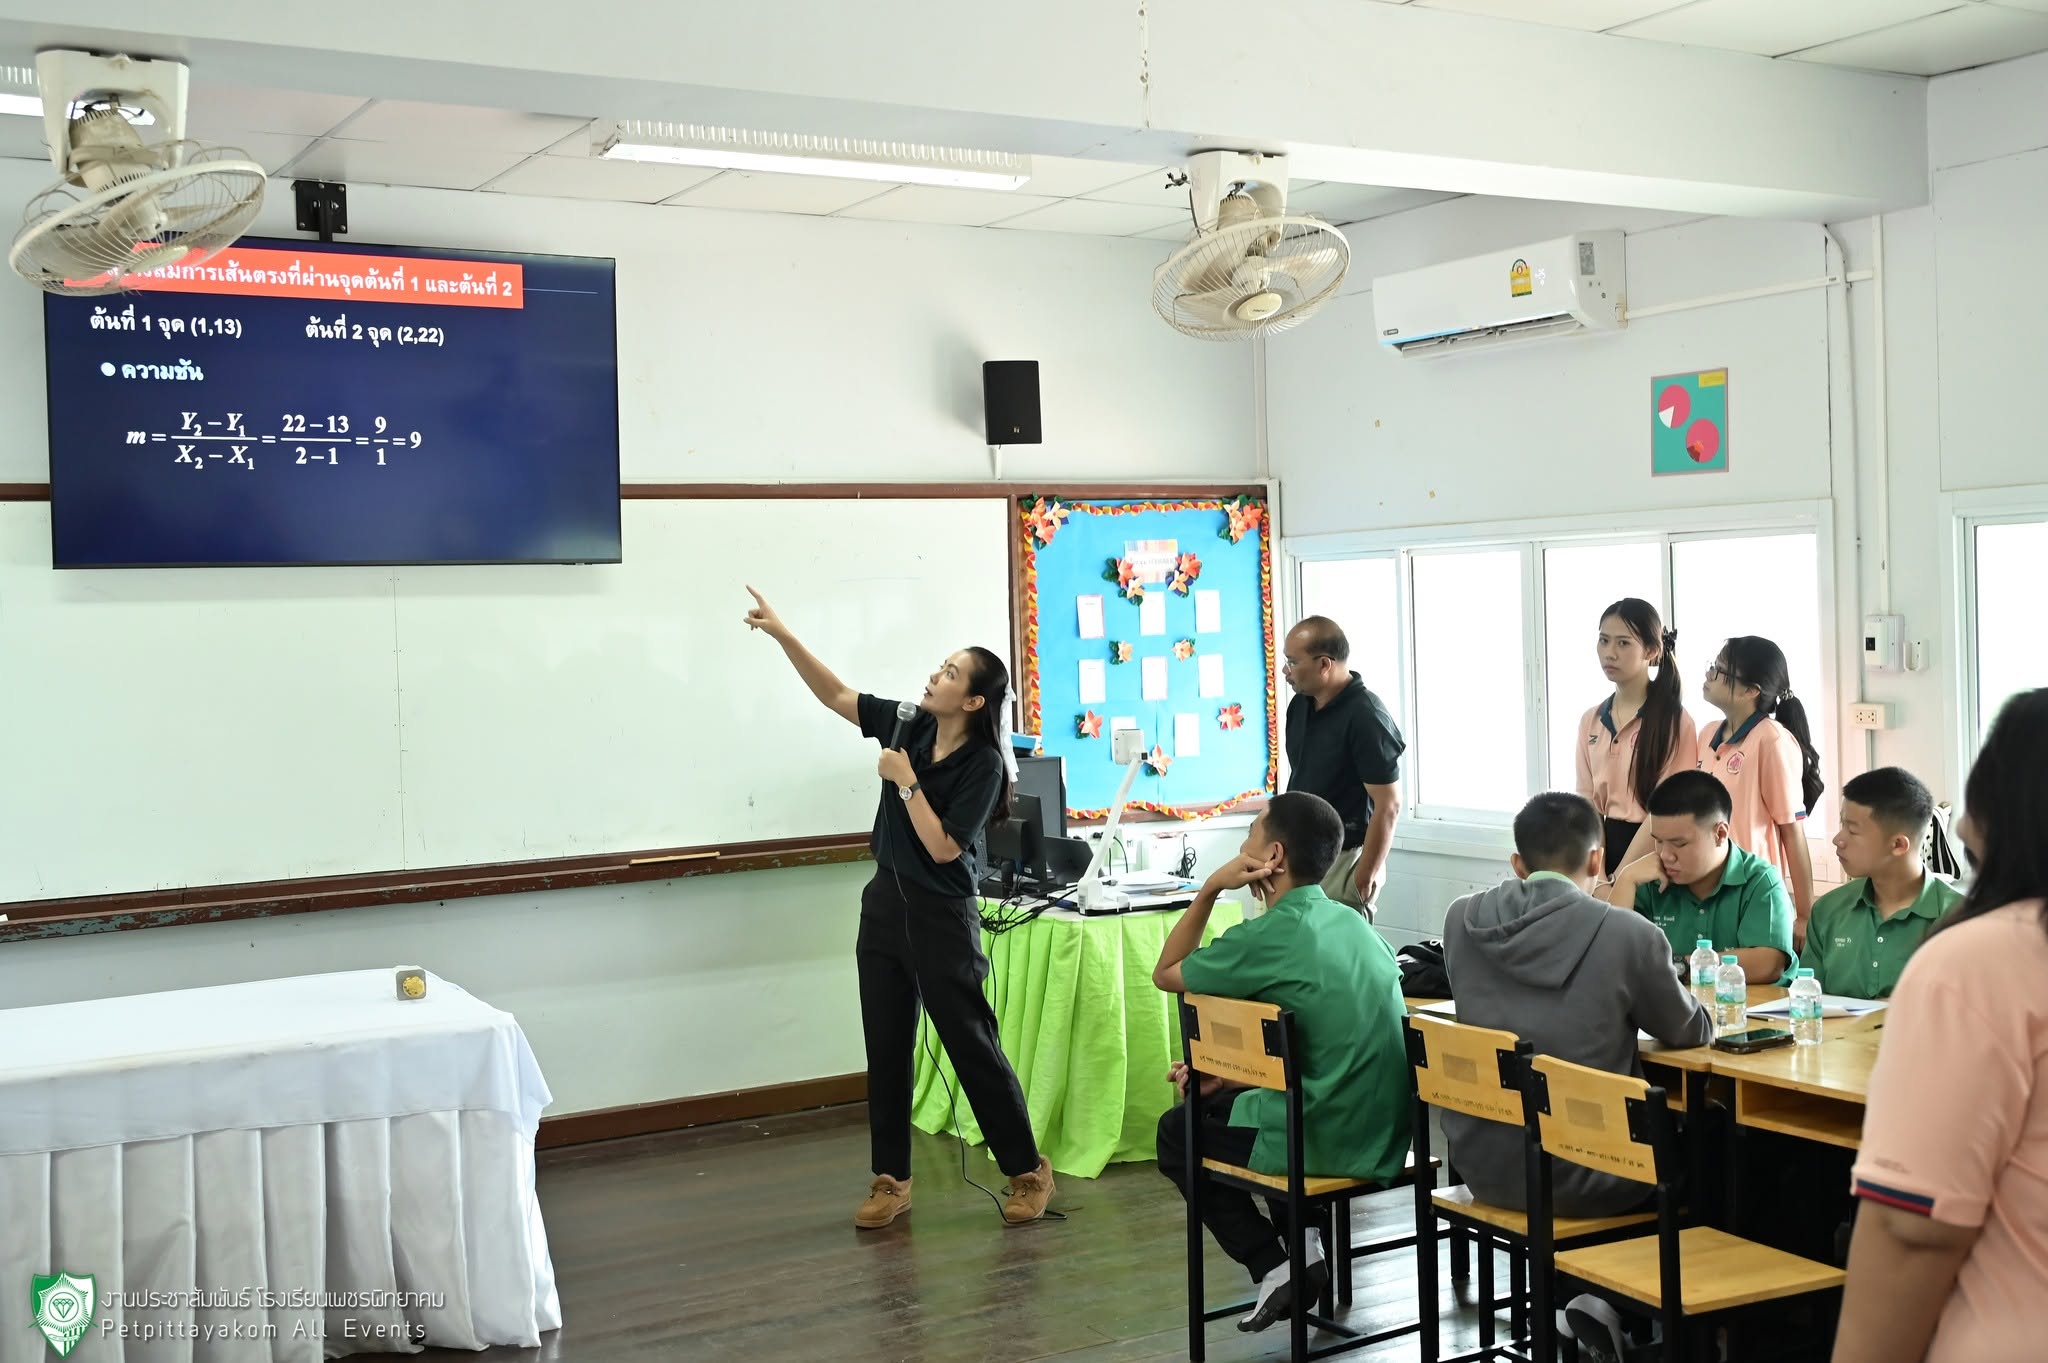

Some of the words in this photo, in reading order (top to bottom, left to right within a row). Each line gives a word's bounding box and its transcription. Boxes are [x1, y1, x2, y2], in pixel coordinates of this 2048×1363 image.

[411, 276, 419, 292] 1
[425, 271, 498, 296] และต้นที่
[502, 281, 513, 297] 2
[90, 304, 136, 331] ต้นที่
[142, 316, 151, 331] 1
[158, 318, 185, 339] จุด
[190, 317, 242, 338] (1,13)
[305, 313, 347, 339] ต้นที่
[352, 324, 363, 340] 2
[367, 326, 392, 348] จุด
[397, 326, 445, 347] (2,22)
[121, 358, 204, 381] ความชัน
[374, 416, 387, 434] 9
[126, 431, 146, 444] m
[410, 431, 422, 449] 9
[376, 448, 386, 465] 1
